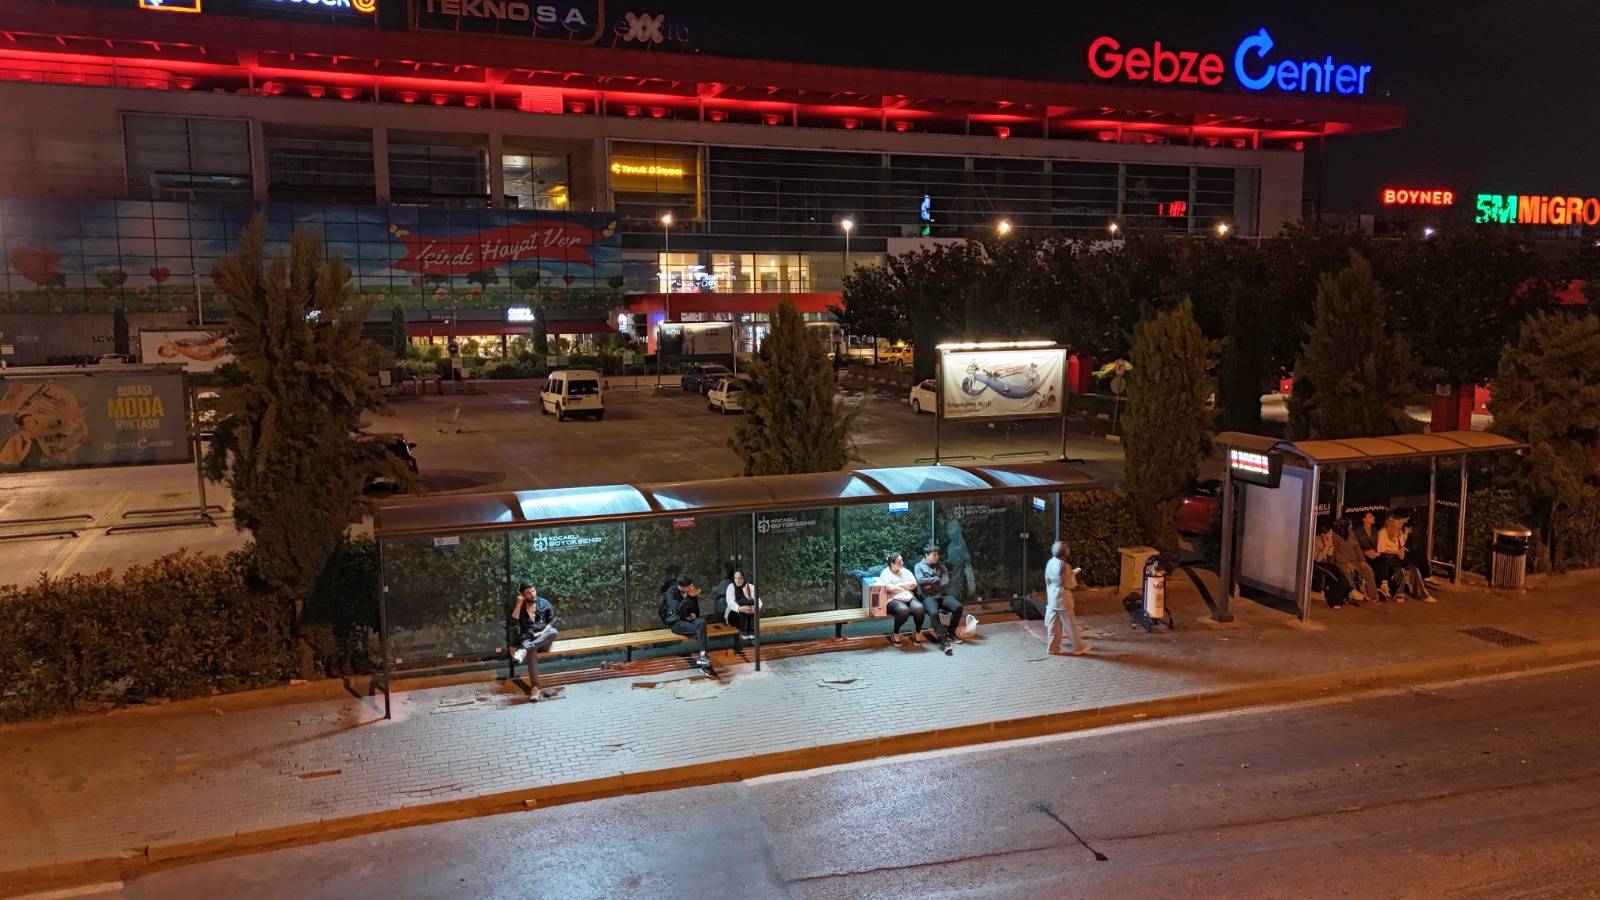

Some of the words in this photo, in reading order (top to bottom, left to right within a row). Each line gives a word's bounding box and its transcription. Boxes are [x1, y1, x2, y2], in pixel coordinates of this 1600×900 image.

[1088, 36, 1224, 86] Gebze
[1234, 27, 1371, 95] Center
[1383, 189, 1453, 205] BOYNER
[481, 231, 538, 261] Hayat
[543, 227, 582, 249] Var
[107, 395, 165, 418] MODA
